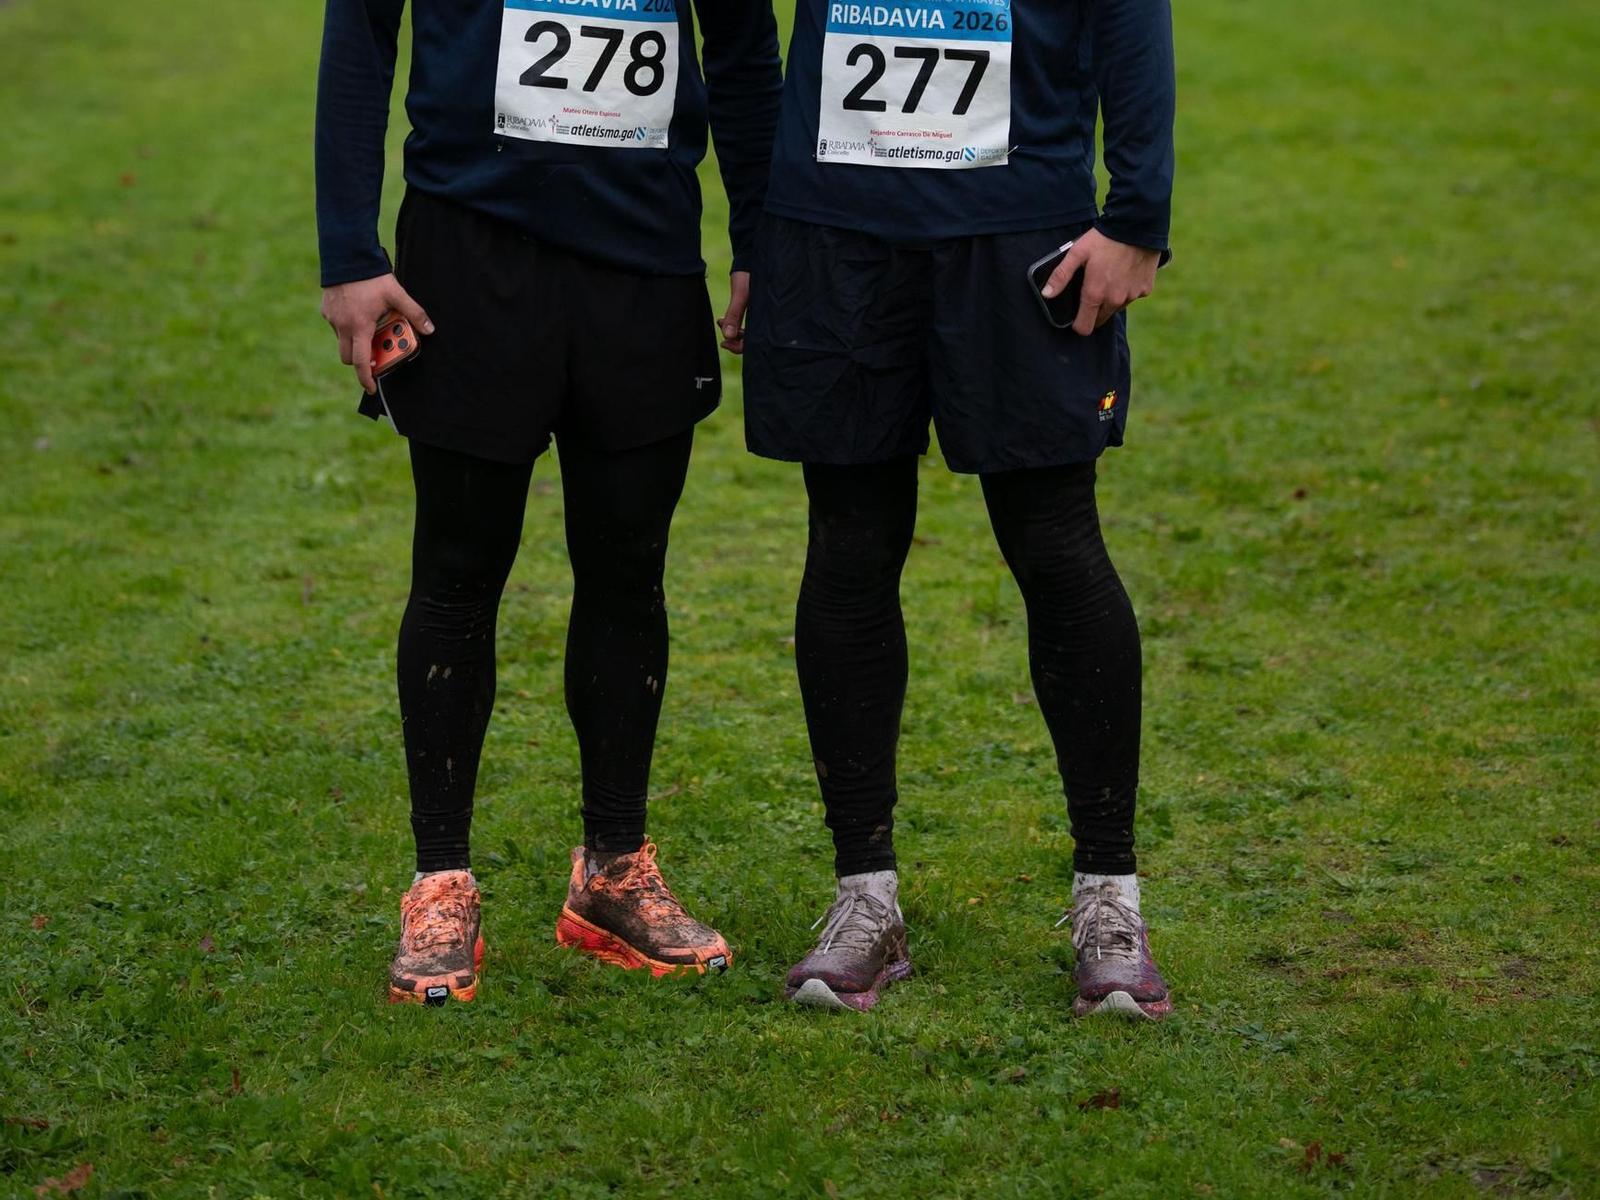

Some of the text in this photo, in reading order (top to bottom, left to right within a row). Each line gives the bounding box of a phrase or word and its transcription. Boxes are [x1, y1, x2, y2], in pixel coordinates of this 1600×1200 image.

[831, 3, 1008, 32] RIBADAVIA 2026
[519, 20, 667, 97] 278
[843, 43, 990, 116] 277
[562, 107, 621, 119] Mateo Otero Espinosa
[570, 124, 637, 141] atletismo.gal
[896, 130, 921, 138] Carrasco
[931, 132, 953, 140] Miguel
[888, 146, 964, 163] atletismo.gal
